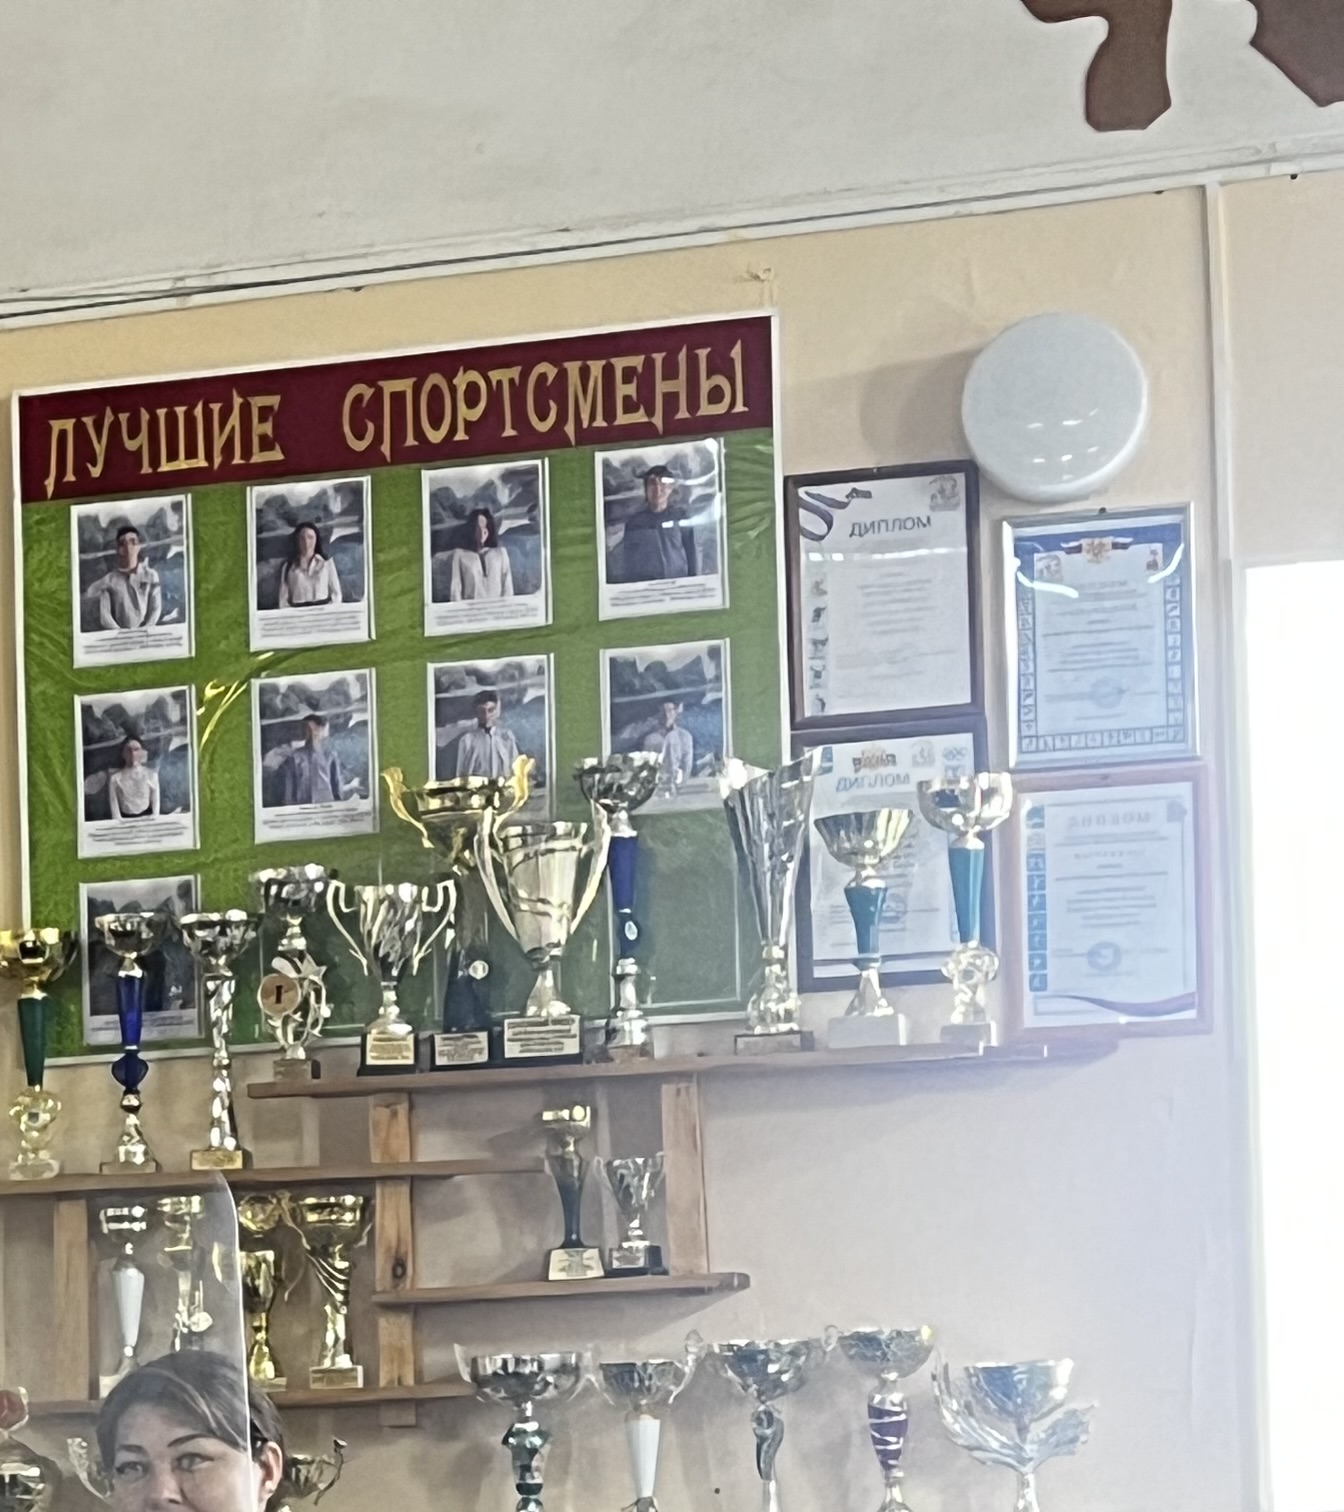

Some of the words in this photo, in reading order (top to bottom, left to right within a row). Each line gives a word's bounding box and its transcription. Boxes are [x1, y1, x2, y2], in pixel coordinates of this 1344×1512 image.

[44, 388, 285, 499] ЛУЧШИЕ
[342, 339, 750, 463] СПОРТСМЕНЫ
[848, 515, 932, 538] ДИПЛОМ
[835, 772, 911, 793] ДИПЛОМ
